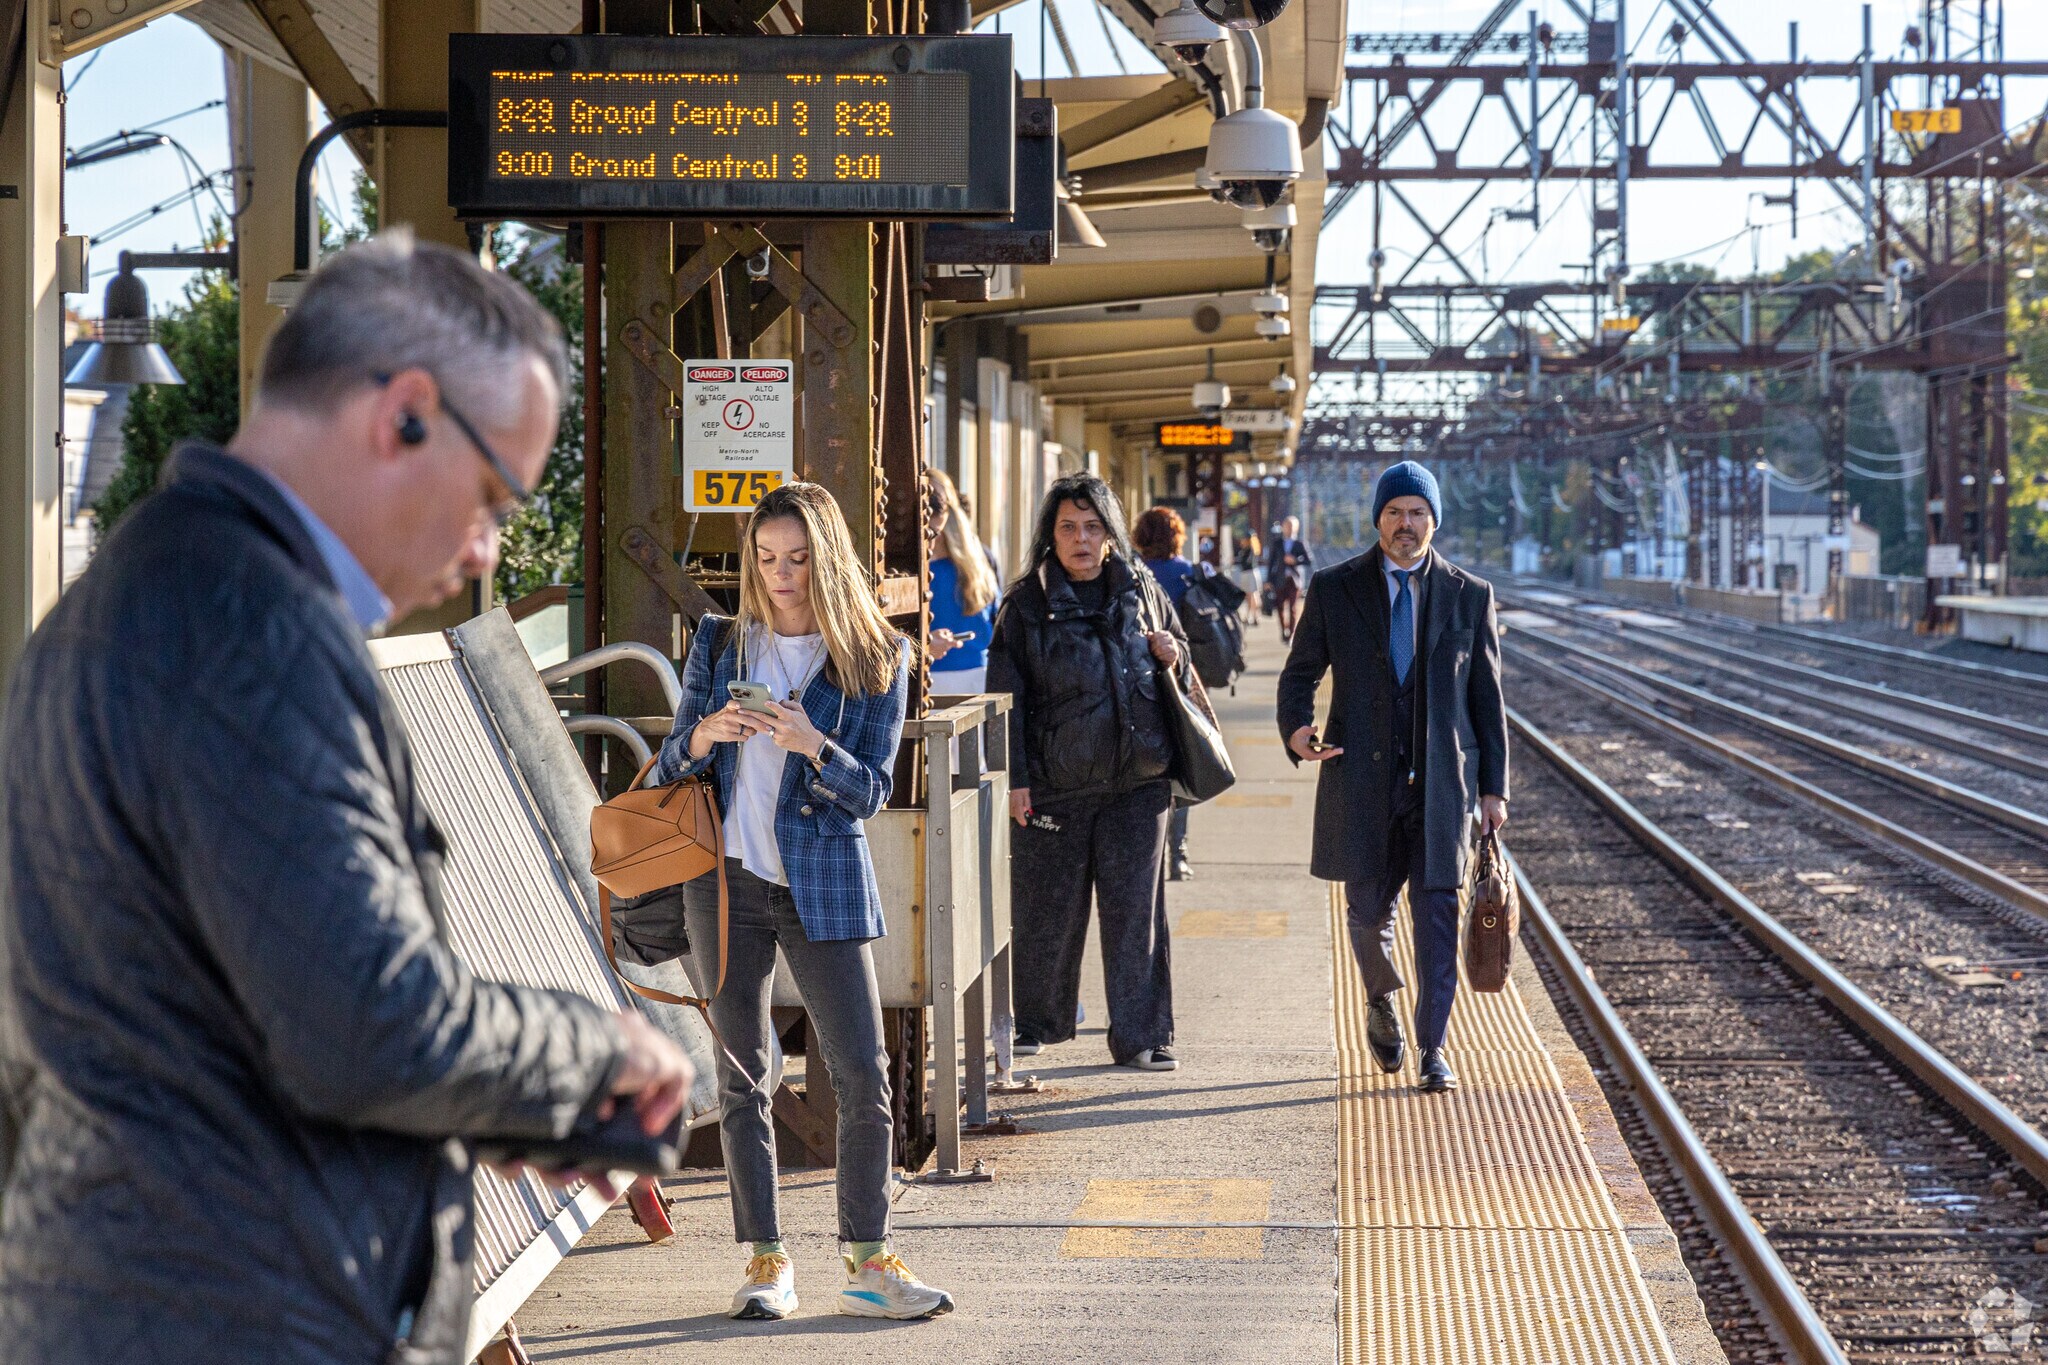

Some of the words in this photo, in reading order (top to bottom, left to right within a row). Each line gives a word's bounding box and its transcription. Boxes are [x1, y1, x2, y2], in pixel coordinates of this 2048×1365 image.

[498, 98, 554, 123] 8:29
[571, 99, 656, 124] Grand
[672, 100, 779, 126] Central
[792, 101, 808, 126] 3
[835, 101, 891, 126] 8:29
[1900, 110, 1951, 130] 576
[498, 151, 553, 176] 9:00
[570, 152, 656, 178] Grand
[672, 153, 779, 179] Central
[792, 154, 808, 179] 3
[835, 154, 881, 179] 9:01
[694, 370, 729, 379] DANGER
[747, 370, 783, 379] PELIGRO
[705, 472, 768, 504] 575
[1032, 818, 1061, 832] HAPPY
[1041, 814, 1053, 823] BE
